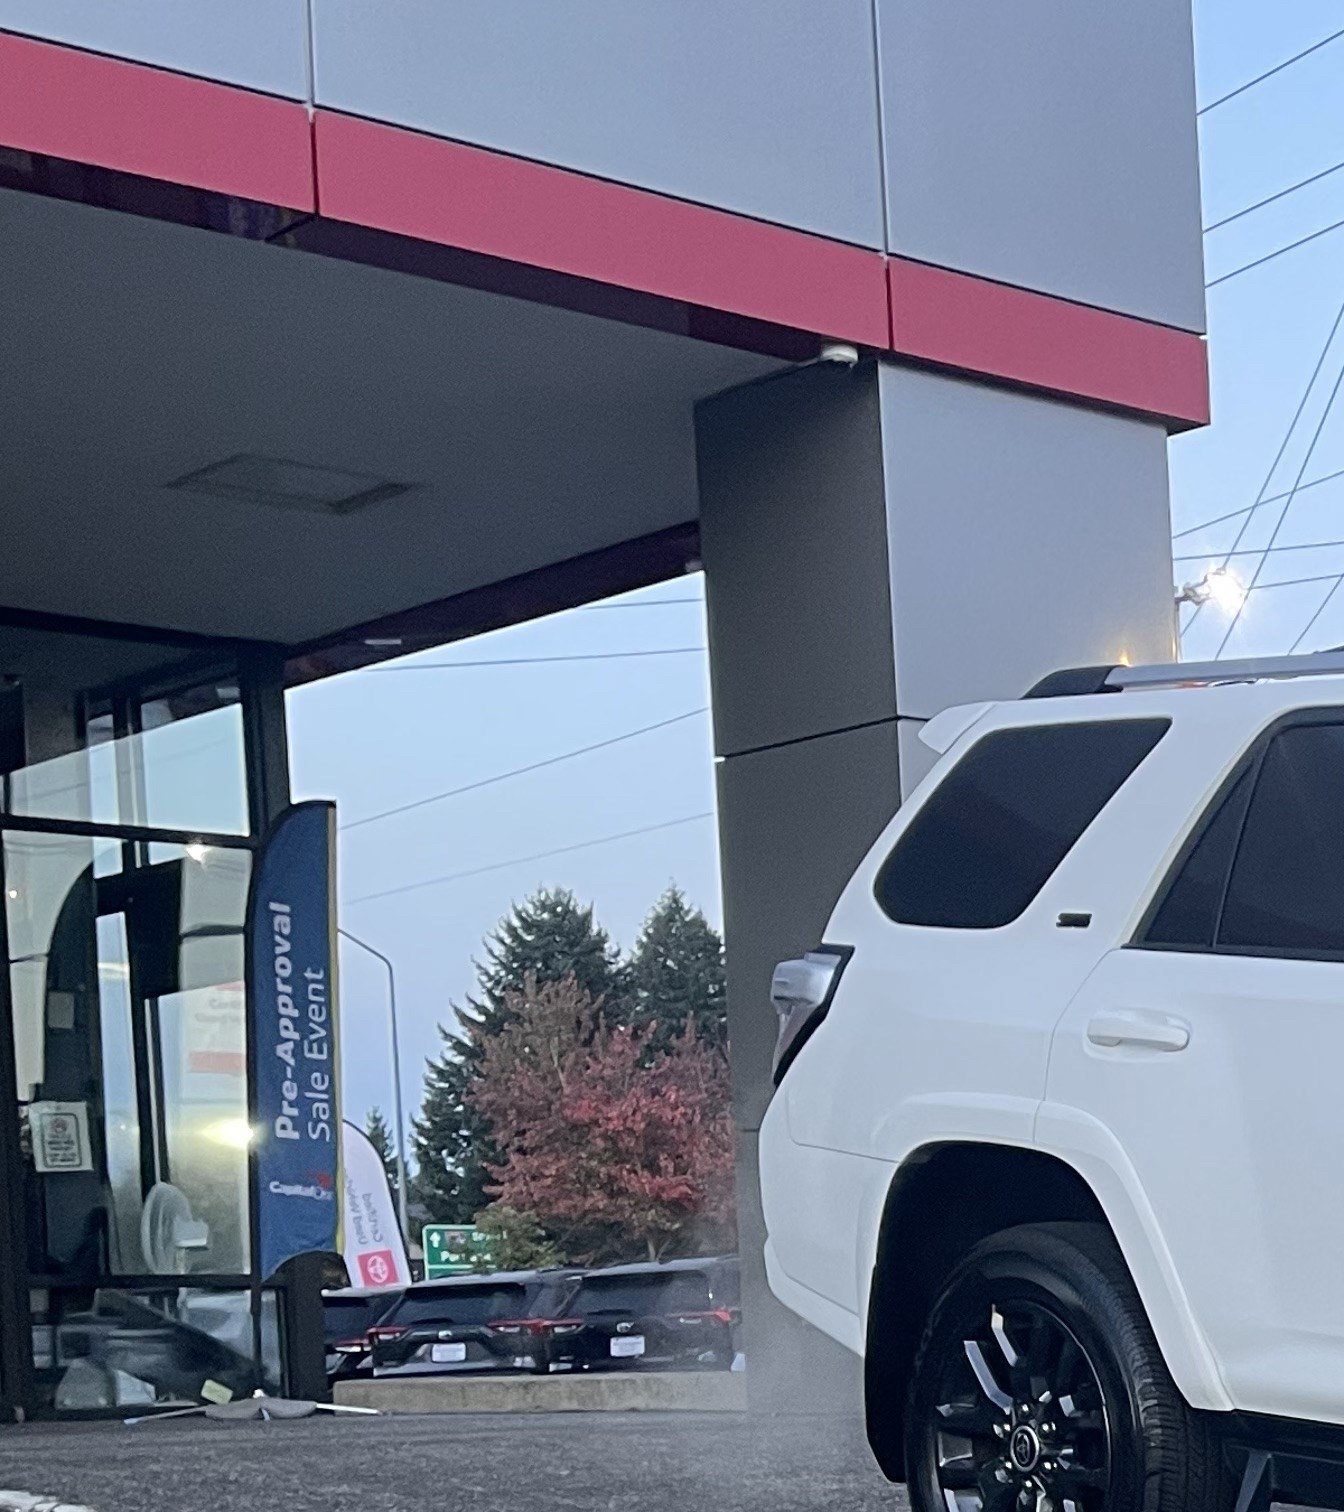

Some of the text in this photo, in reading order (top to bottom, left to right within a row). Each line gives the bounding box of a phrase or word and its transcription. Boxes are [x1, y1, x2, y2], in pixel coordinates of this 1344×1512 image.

[268, 900, 301, 1141] Pre-Approval
[303, 965, 331, 1143] Sale Event
